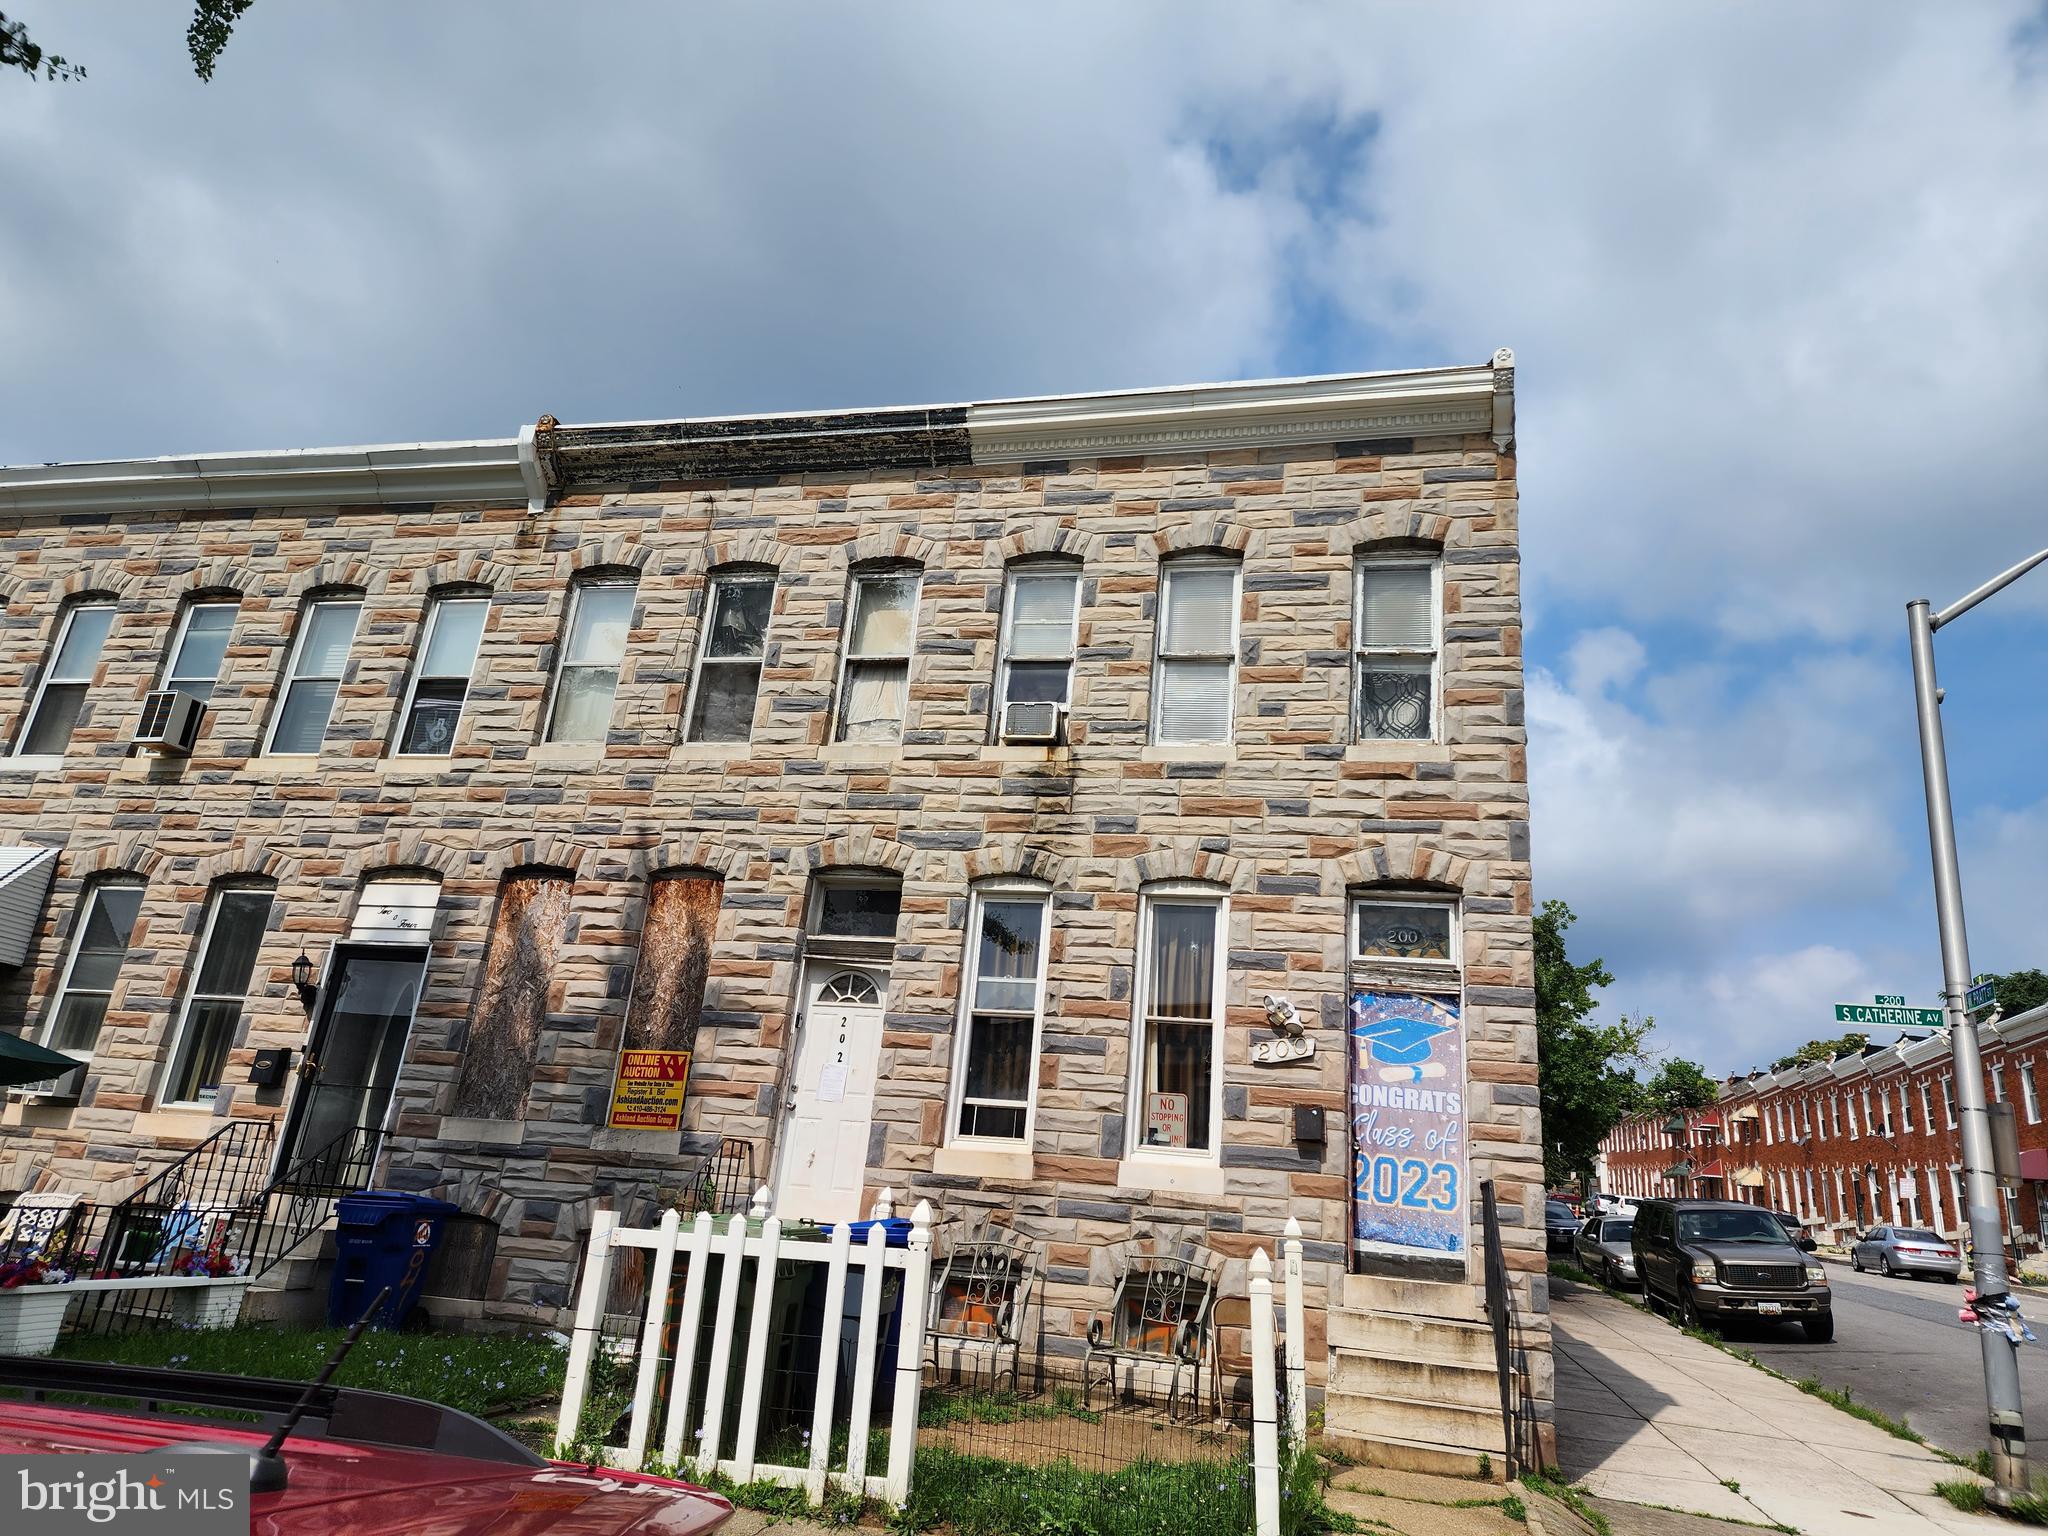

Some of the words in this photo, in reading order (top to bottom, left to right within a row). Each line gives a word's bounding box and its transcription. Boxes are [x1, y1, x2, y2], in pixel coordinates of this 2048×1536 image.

[1387, 930, 1418, 943] 200
[1884, 996, 1901, 1005] 200
[1843, 1007, 1854, 1021] S.
[1856, 1008, 1923, 1024] CATHERINE
[1926, 1014, 1942, 1023] AV.
[1258, 1037, 1308, 1061] 200
[628, 1054, 660, 1065] ONLINE
[623, 1066, 660, 1077] AUCTION
[627, 1087, 648, 1097] Register
[656, 1088, 666, 1096] Bid
[616, 1095, 679, 1106] AshlandAuction.com
[1160, 1098, 1175, 1111] NO
[1351, 1084, 1461, 1115] CONGRATS
[615, 1113, 636, 1123] Ashland
[636, 1114, 656, 1124] Auction
[656, 1115, 673, 1126] Group
[1151, 1112, 1184, 1122] STOPPING
[1162, 1123, 1172, 1132] OR
[1353, 1110, 1415, 1149] Class
[1425, 1120, 1459, 1160] of
[1355, 1153, 1461, 1216] 2023
